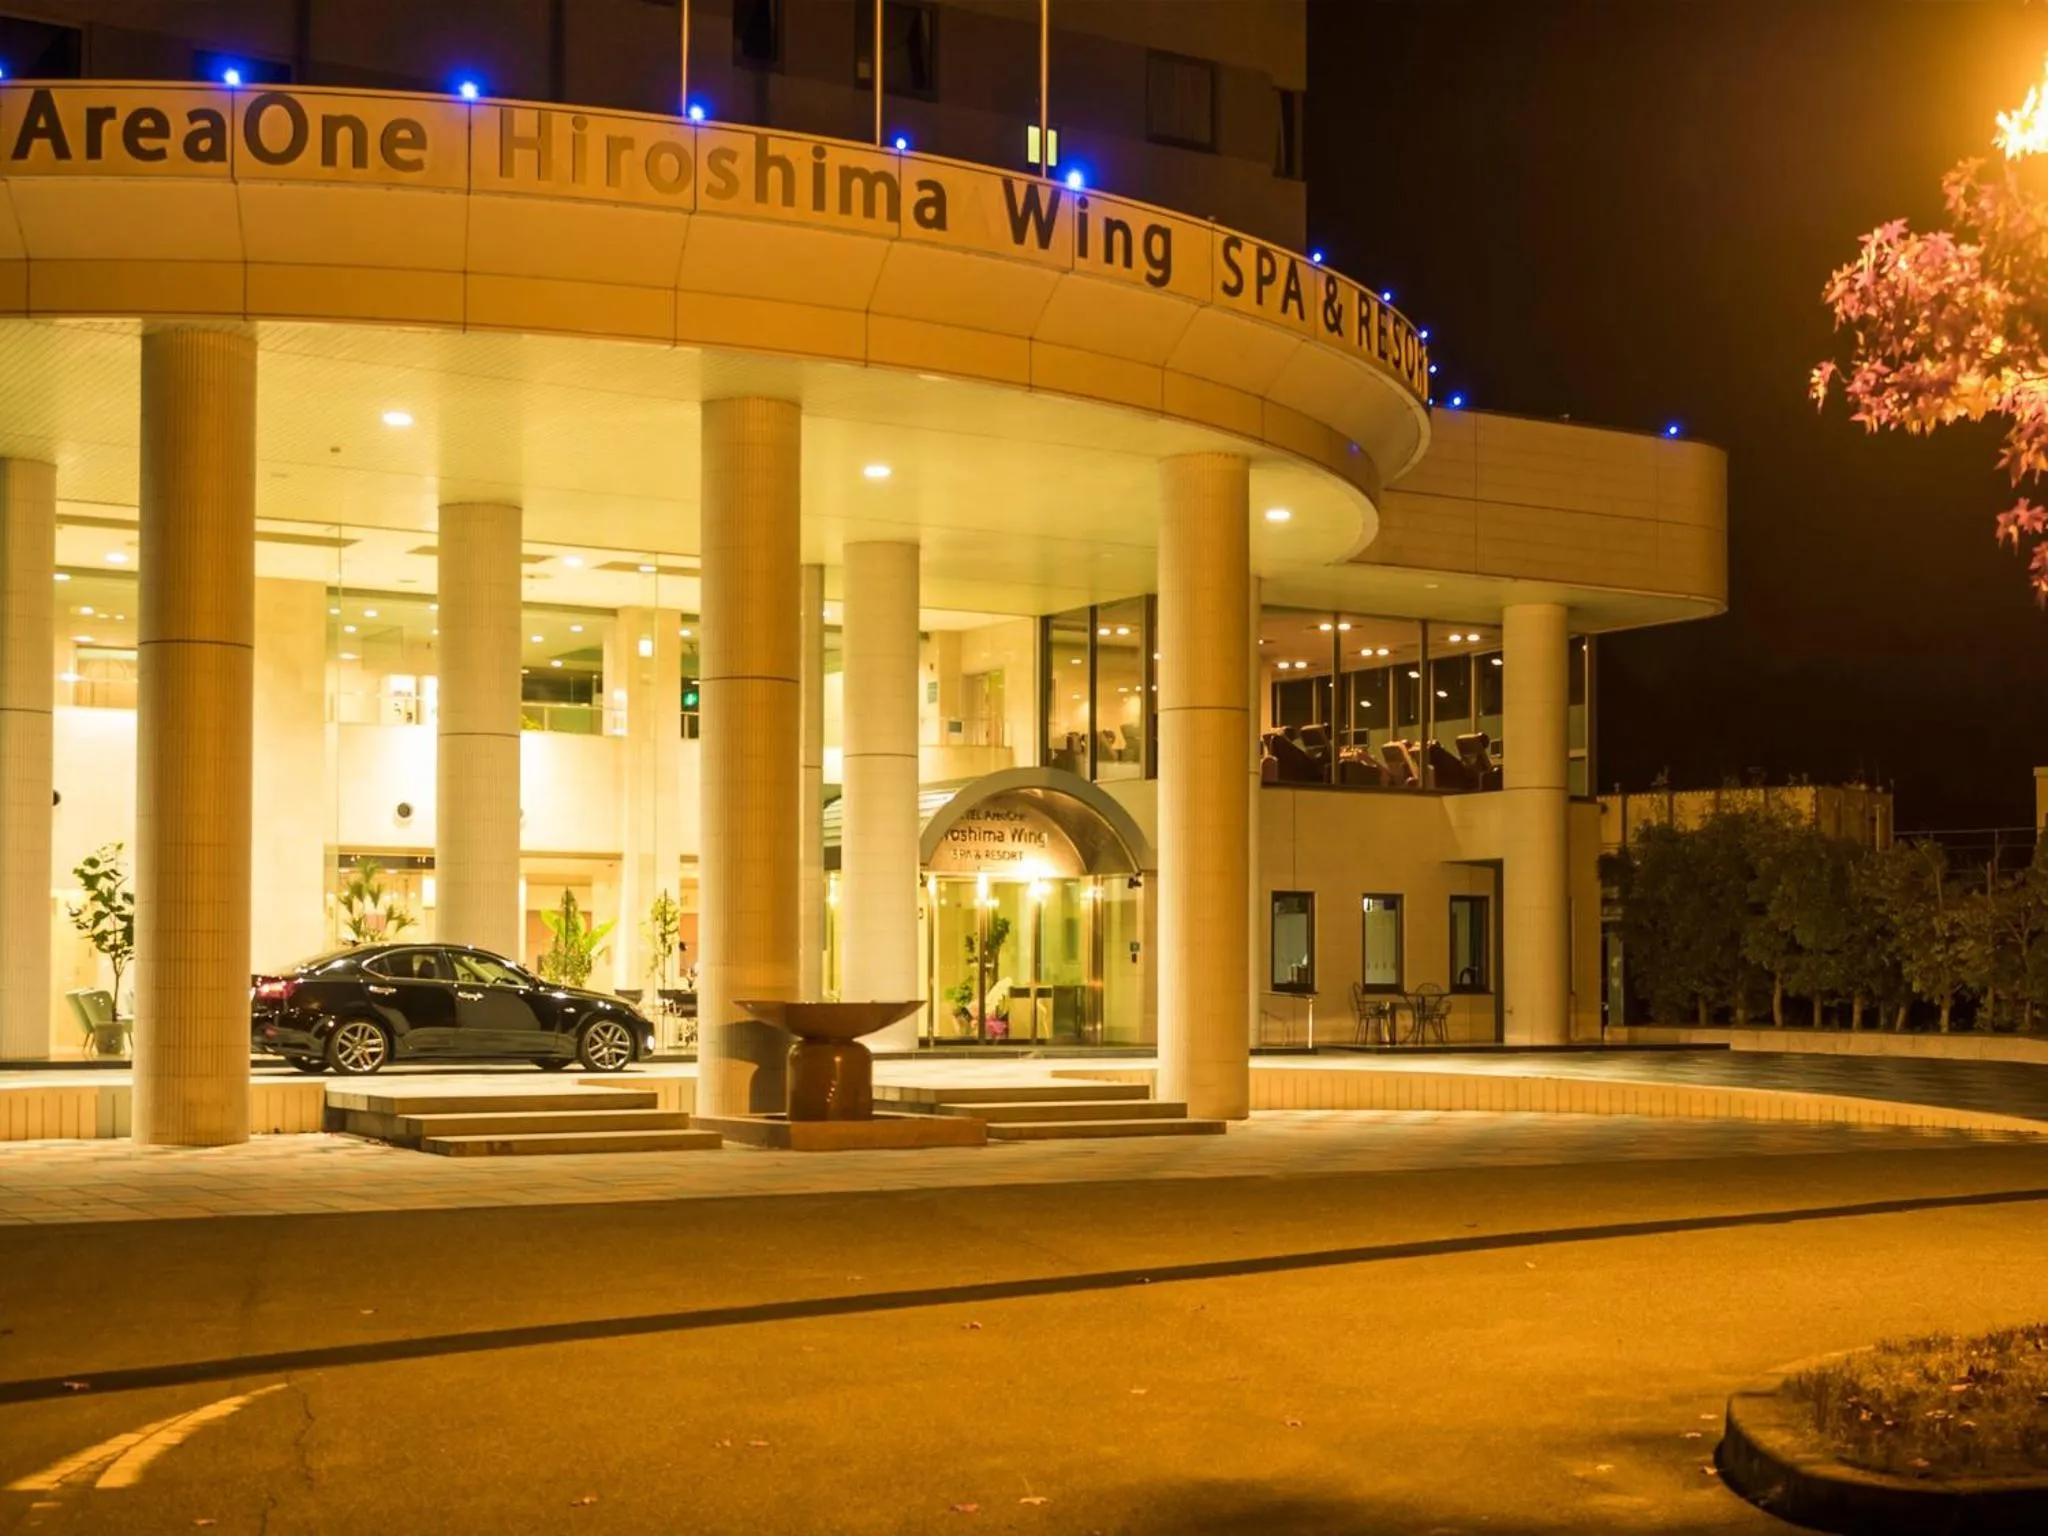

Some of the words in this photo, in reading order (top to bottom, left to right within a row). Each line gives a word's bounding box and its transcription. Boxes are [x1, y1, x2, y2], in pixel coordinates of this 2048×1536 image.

[11, 88, 428, 173] AreaOne
[499, 106, 948, 231] Hiroshima
[1002, 178, 1172, 288] Wing
[1221, 236, 1306, 321] SPA
[1323, 275, 1344, 337] &
[1358, 288, 1429, 396] RESOR
[1011, 827, 1048, 849] Wing
